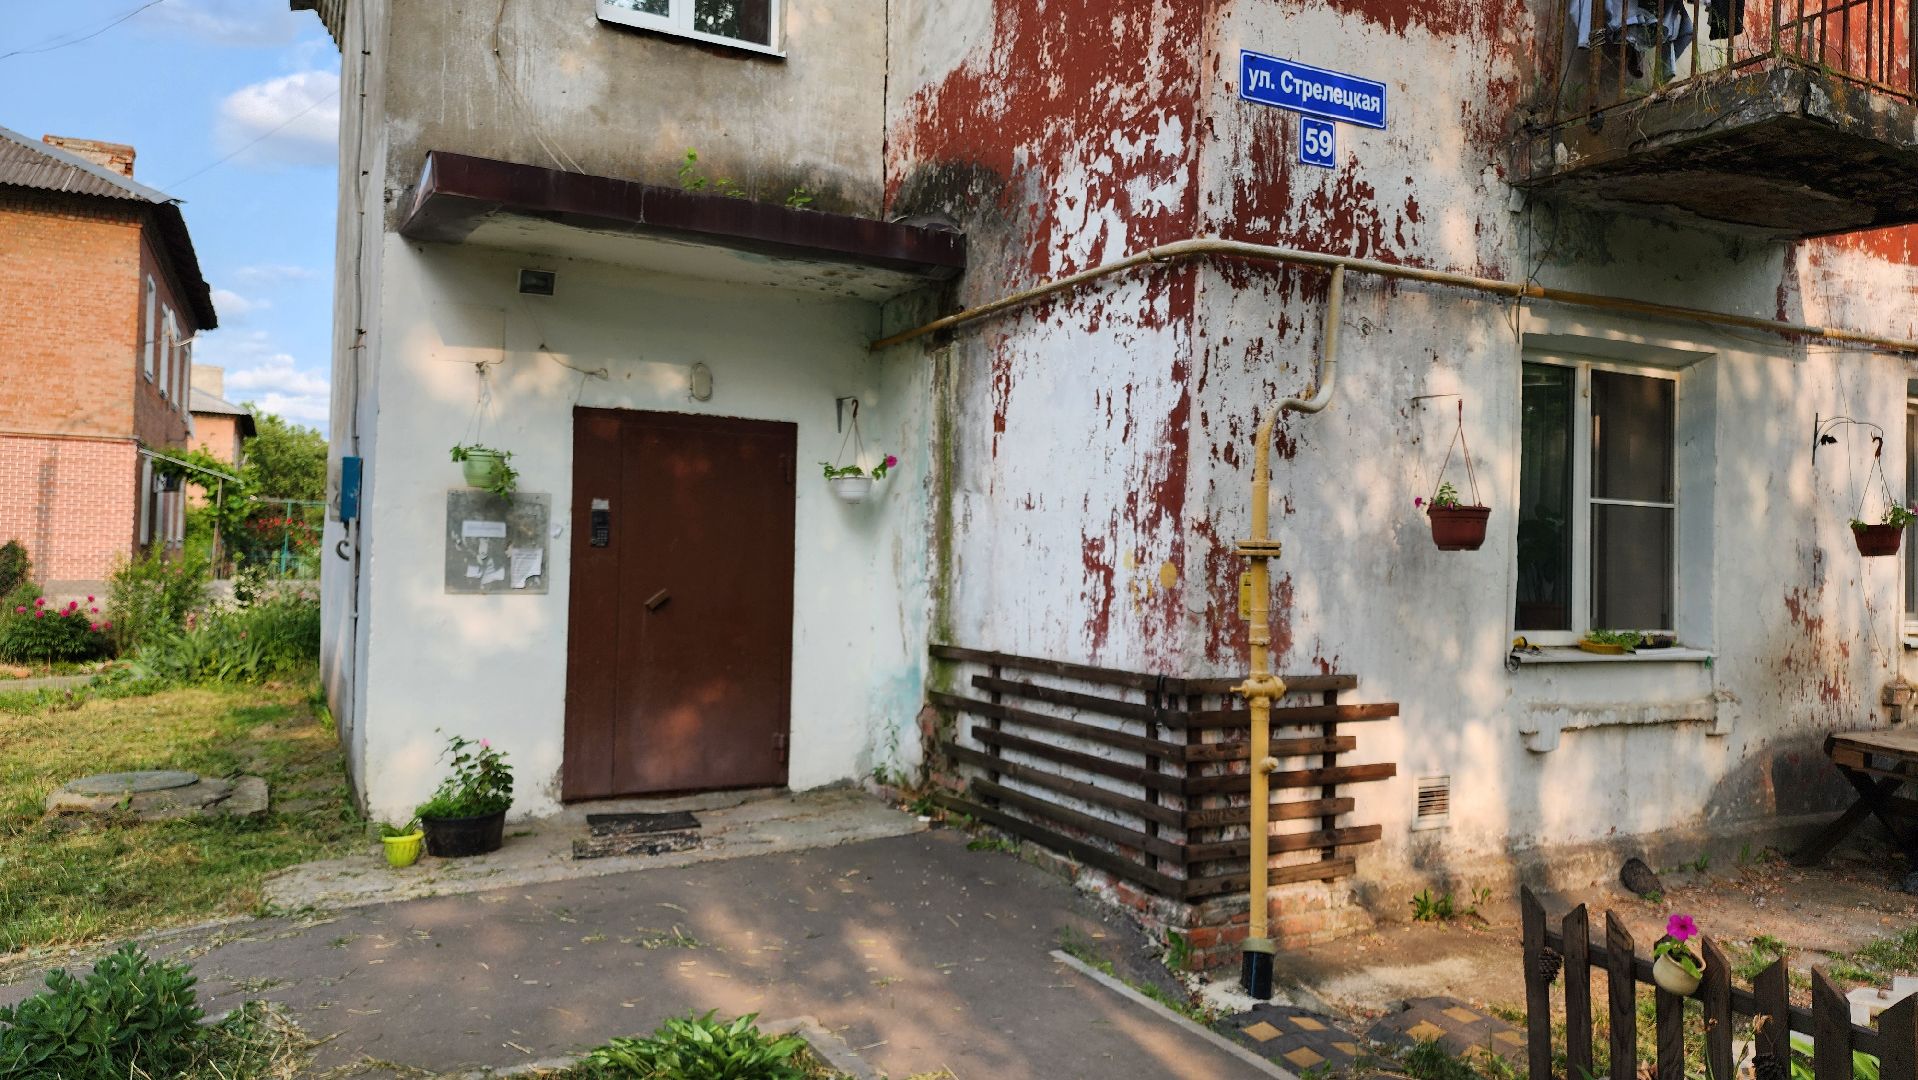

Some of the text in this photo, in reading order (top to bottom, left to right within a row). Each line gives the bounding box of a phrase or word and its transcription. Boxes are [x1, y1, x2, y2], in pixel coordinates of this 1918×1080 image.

[1248, 68, 1380, 113] ул. Стрелецкая
[1305, 127, 1333, 157] 59
